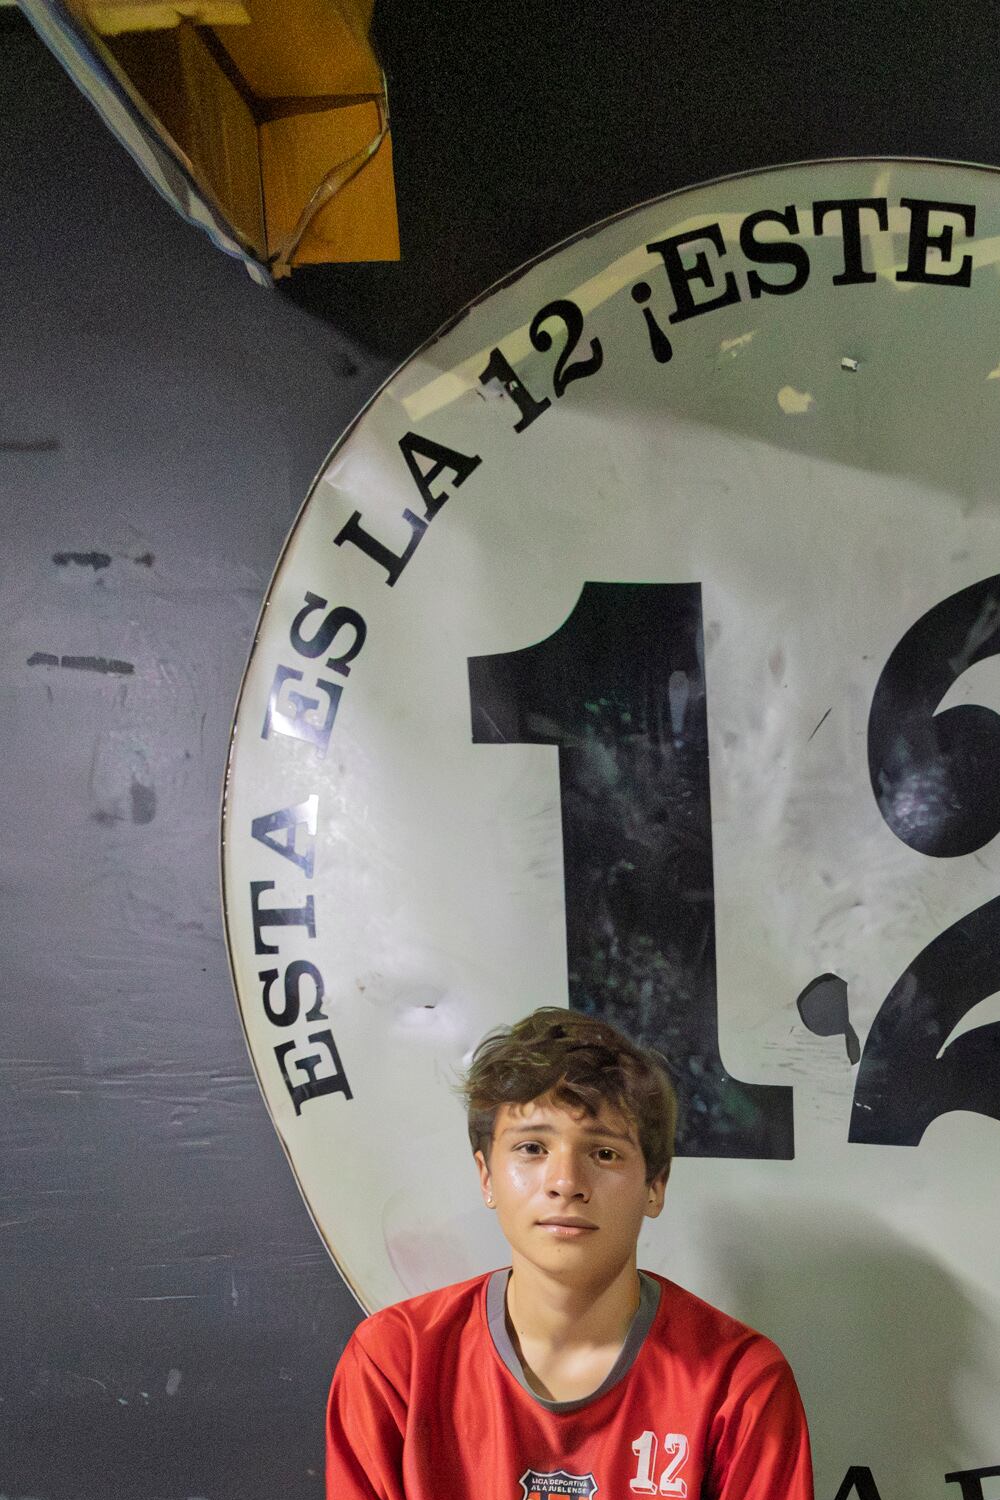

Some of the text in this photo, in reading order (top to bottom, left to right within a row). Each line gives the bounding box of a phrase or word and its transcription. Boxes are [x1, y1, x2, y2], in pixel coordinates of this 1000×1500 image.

[250, 299, 604, 1116] ESTA ES LA 12
[550, 1479, 588, 1488] DEPORTIVA
[630, 1430, 690, 1498] 12
[531, 1485, 588, 1495] ALAJUELENSE
